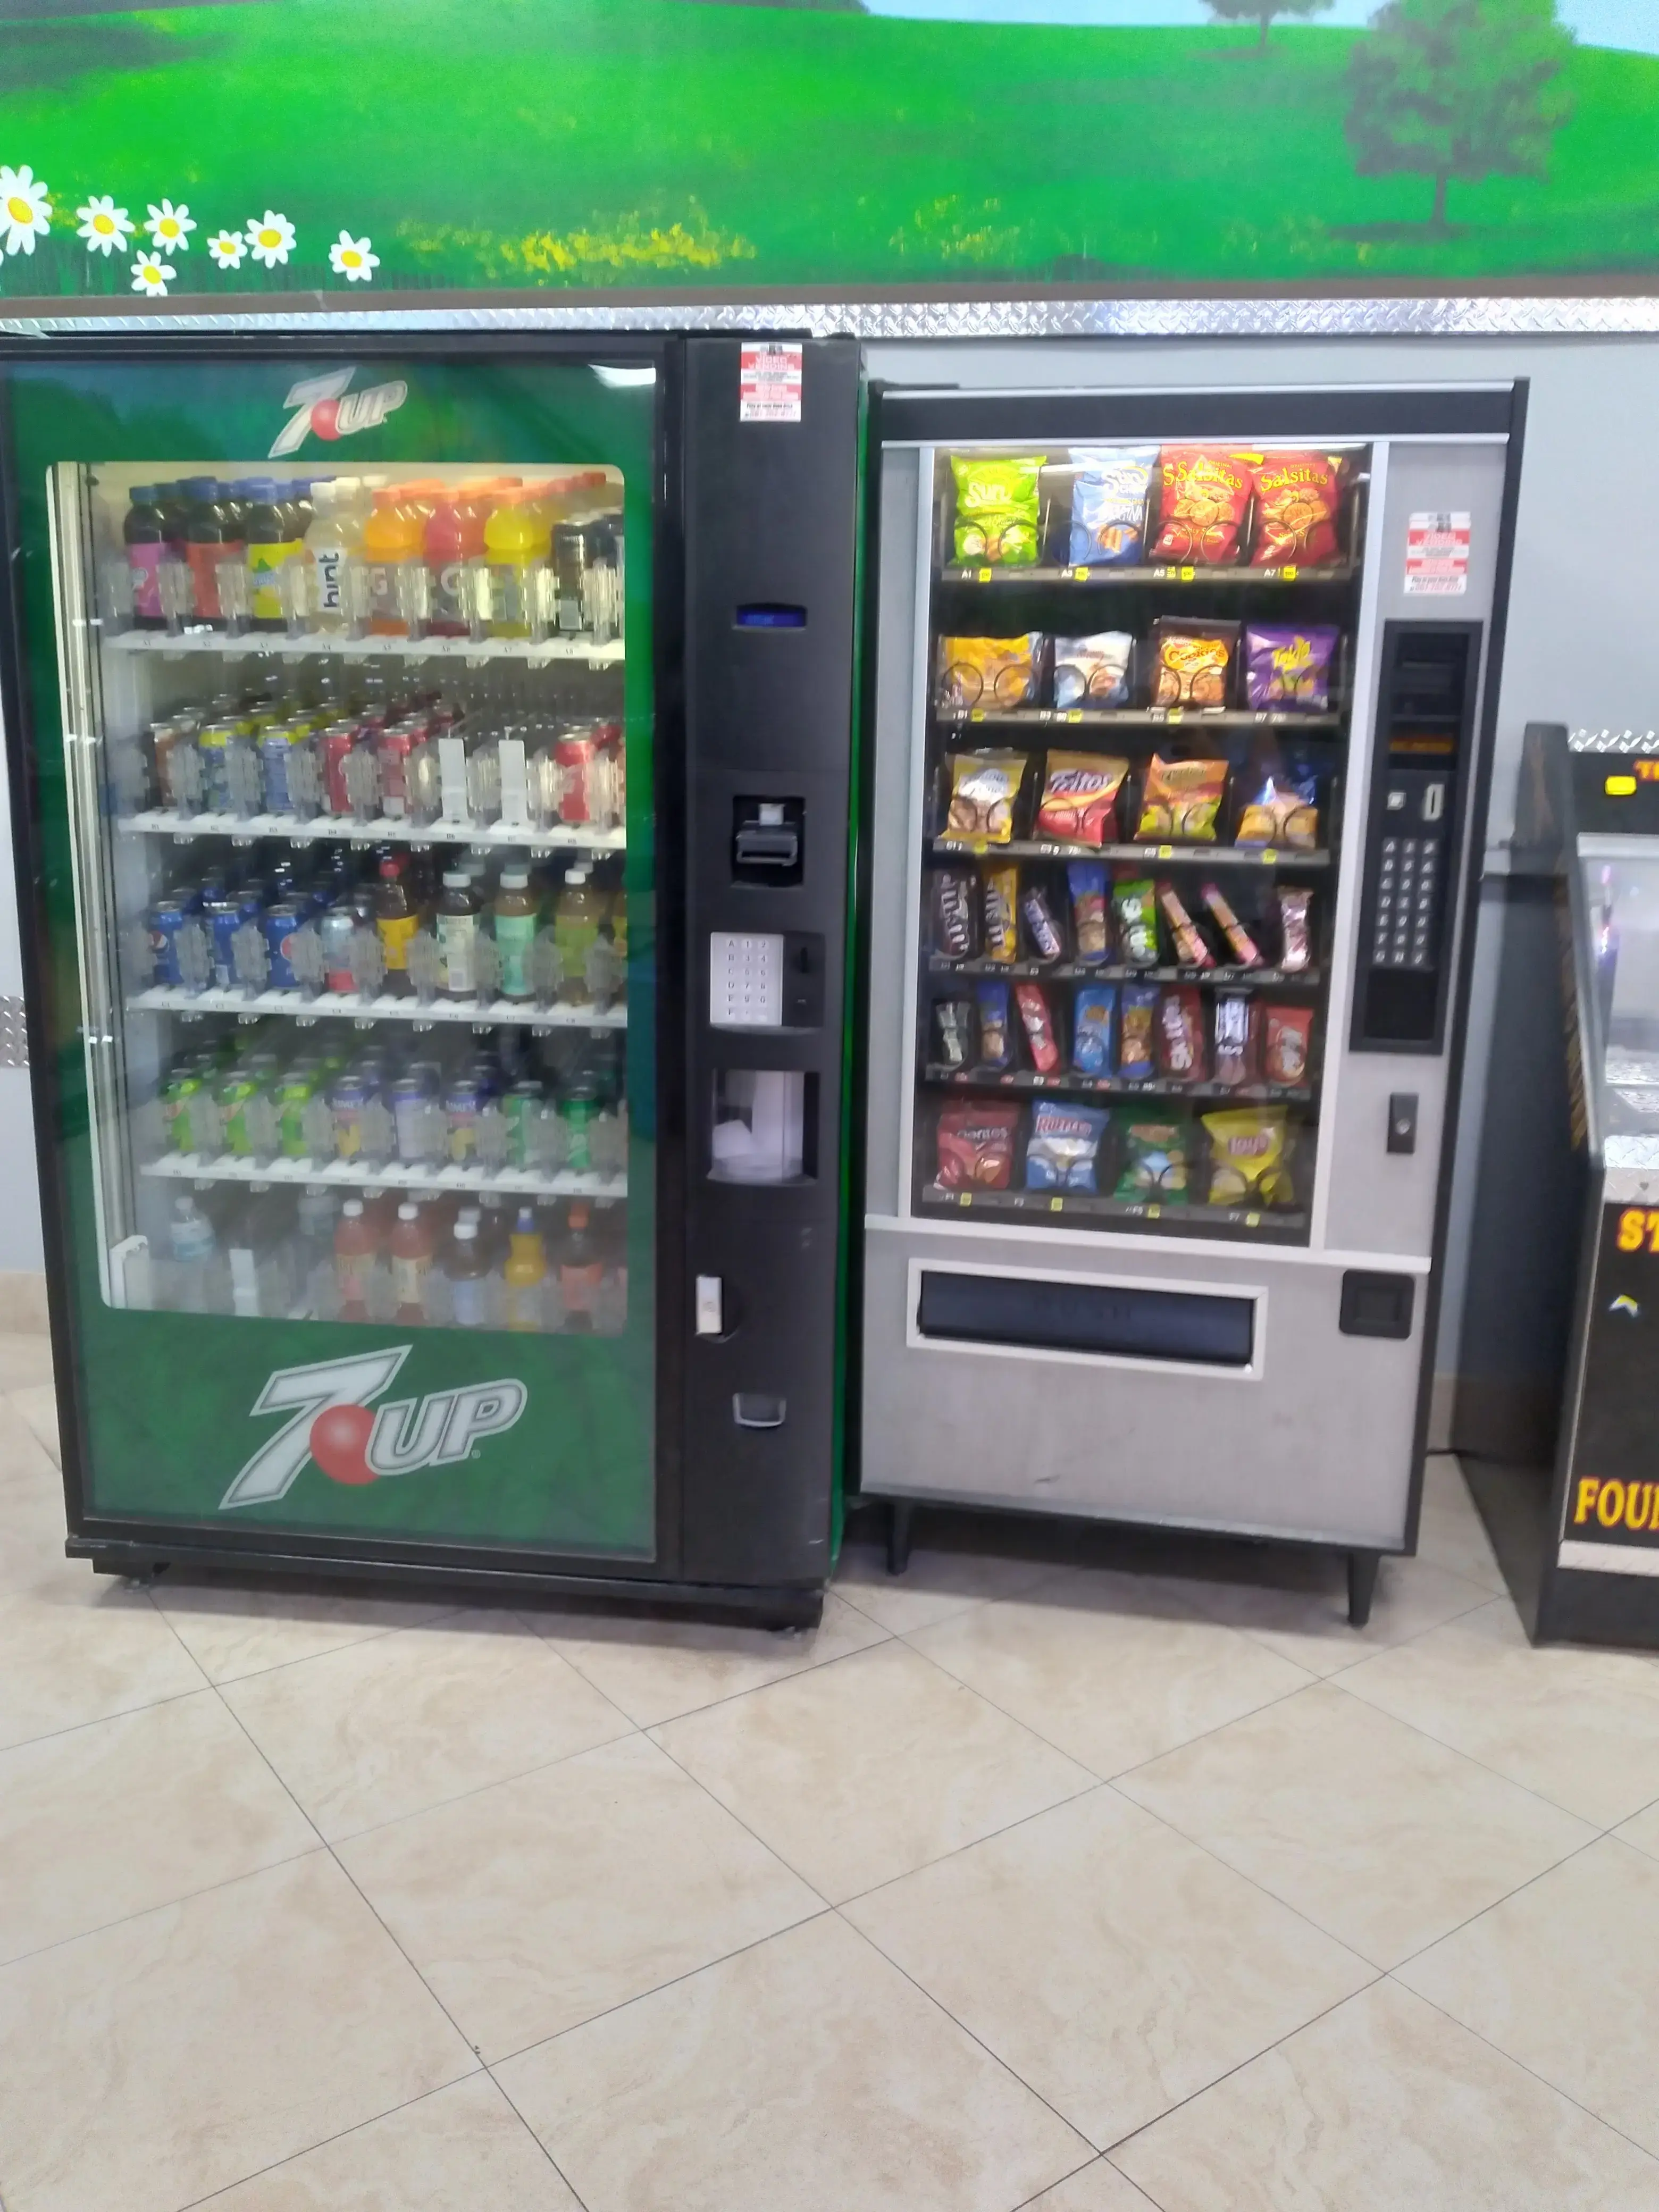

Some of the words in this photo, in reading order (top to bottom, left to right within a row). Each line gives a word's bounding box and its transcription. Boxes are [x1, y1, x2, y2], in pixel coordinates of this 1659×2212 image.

[1176, 460, 1243, 489] Salsitas
[1260, 467, 1329, 492] Salsitas
[965, 481, 1012, 508] Sun
[319, 551, 340, 607] hint
[961, 569, 972, 579] A1
[1153, 568, 1165, 577] A5
[1263, 568, 1276, 577] A7
[1168, 648, 1225, 661] Cookies
[218, 1344, 527, 1510] 7UP
